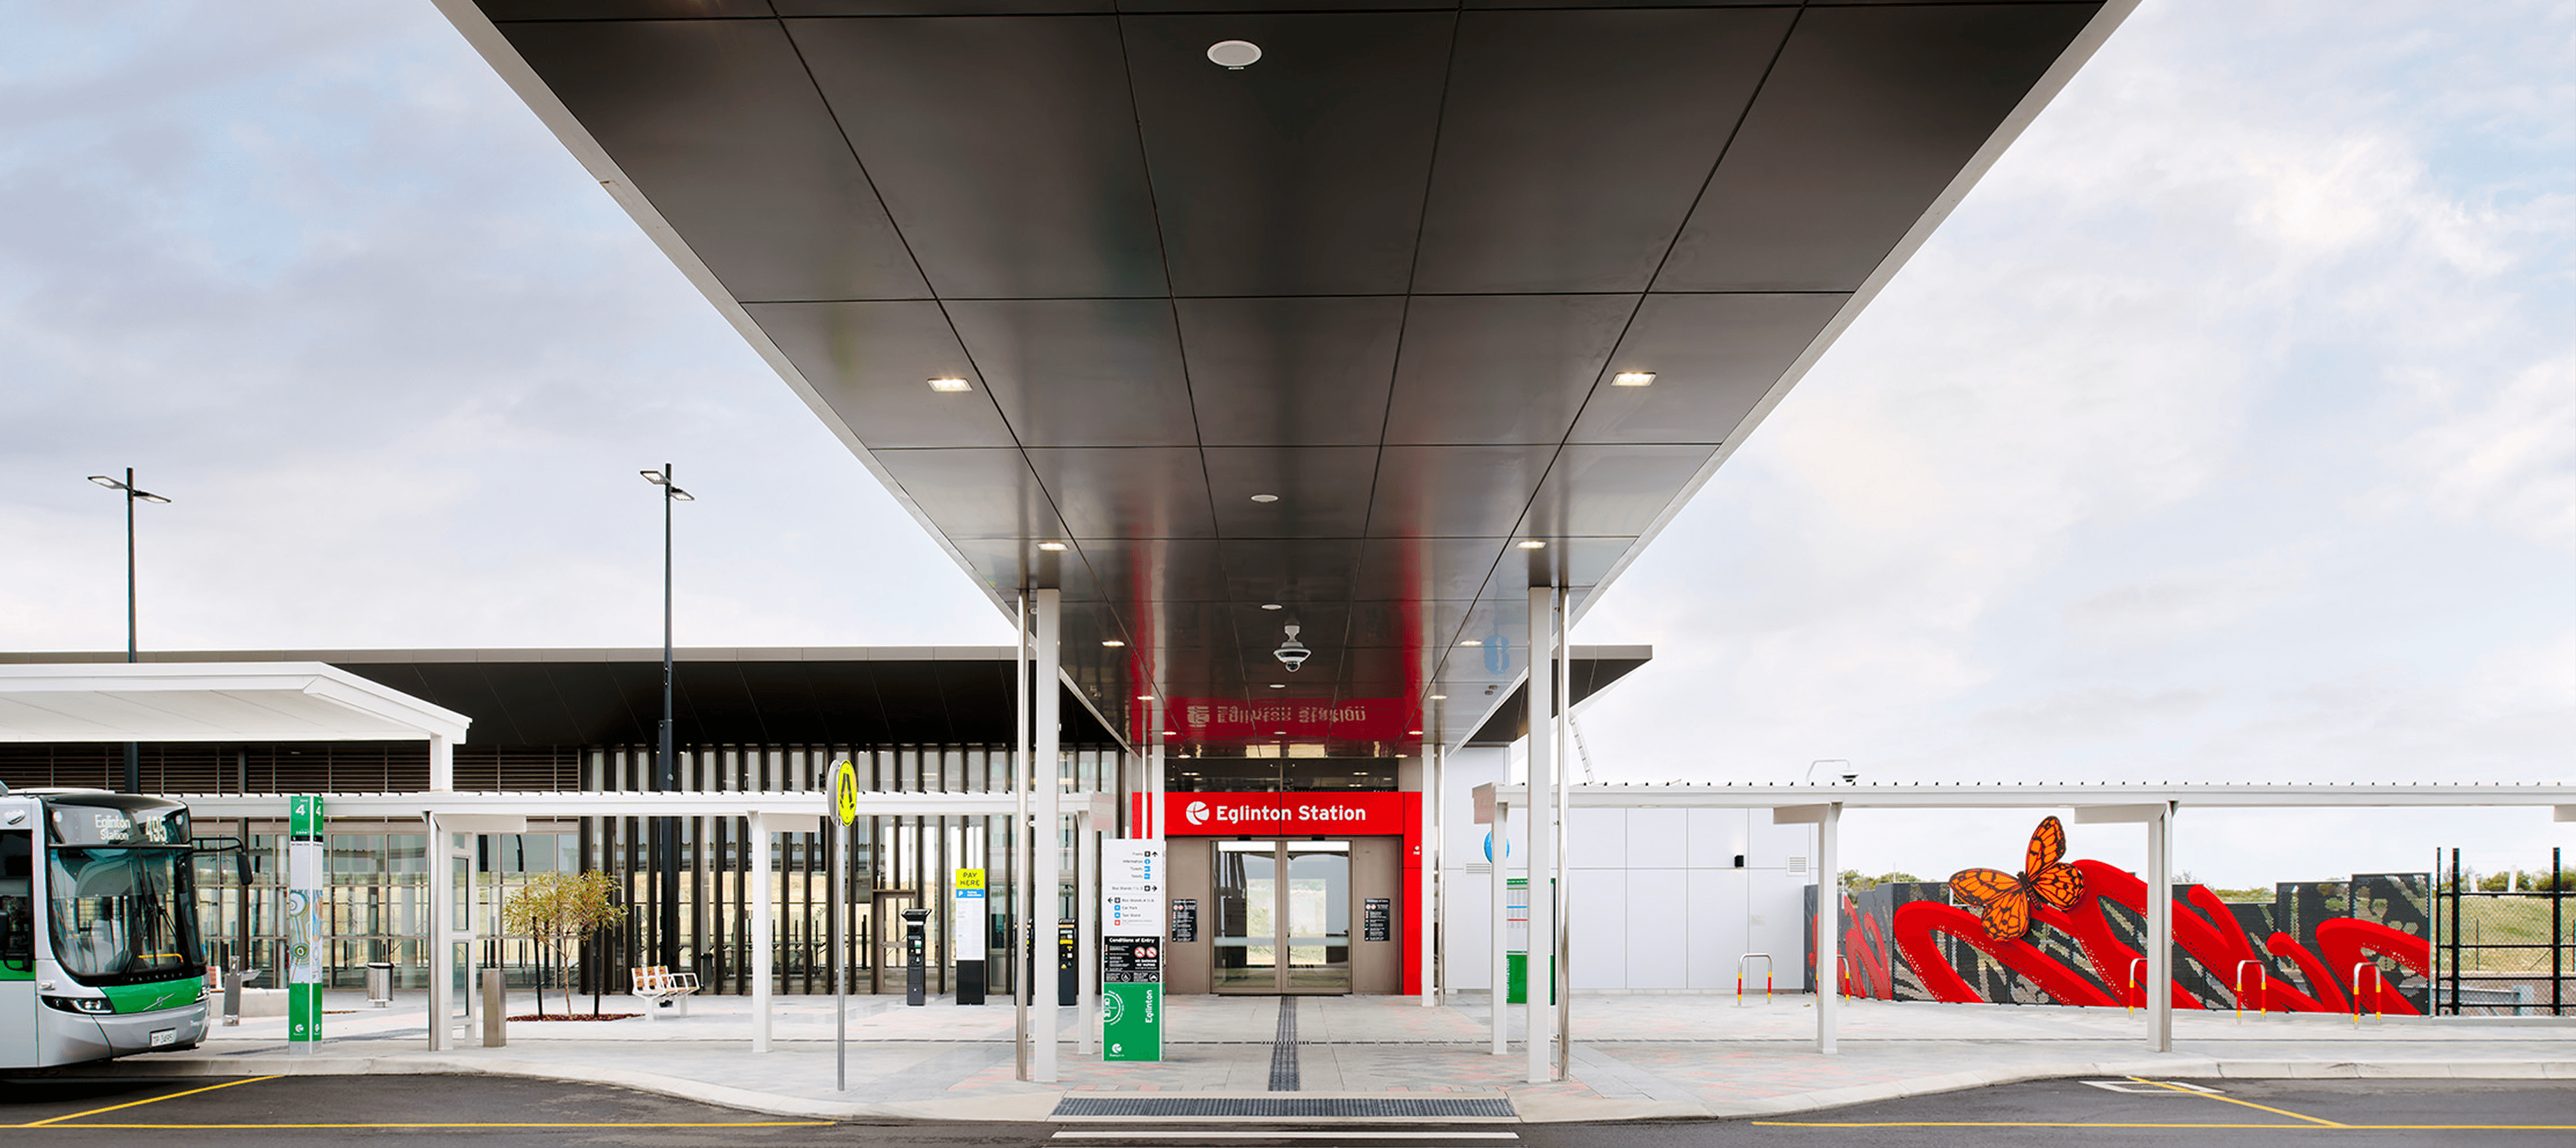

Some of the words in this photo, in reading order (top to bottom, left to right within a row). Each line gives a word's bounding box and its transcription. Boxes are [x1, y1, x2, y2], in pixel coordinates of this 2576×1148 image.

[295, 804, 306, 816] 4
[315, 805, 322, 816] 4
[1217, 805, 1291, 824] Eglinton
[1298, 805, 1366, 821] Station
[94, 814, 131, 830] Eglinton
[145, 816, 168, 842] 495
[100, 829, 129, 840] Station
[1145, 989, 1154, 1023] Eglinton
